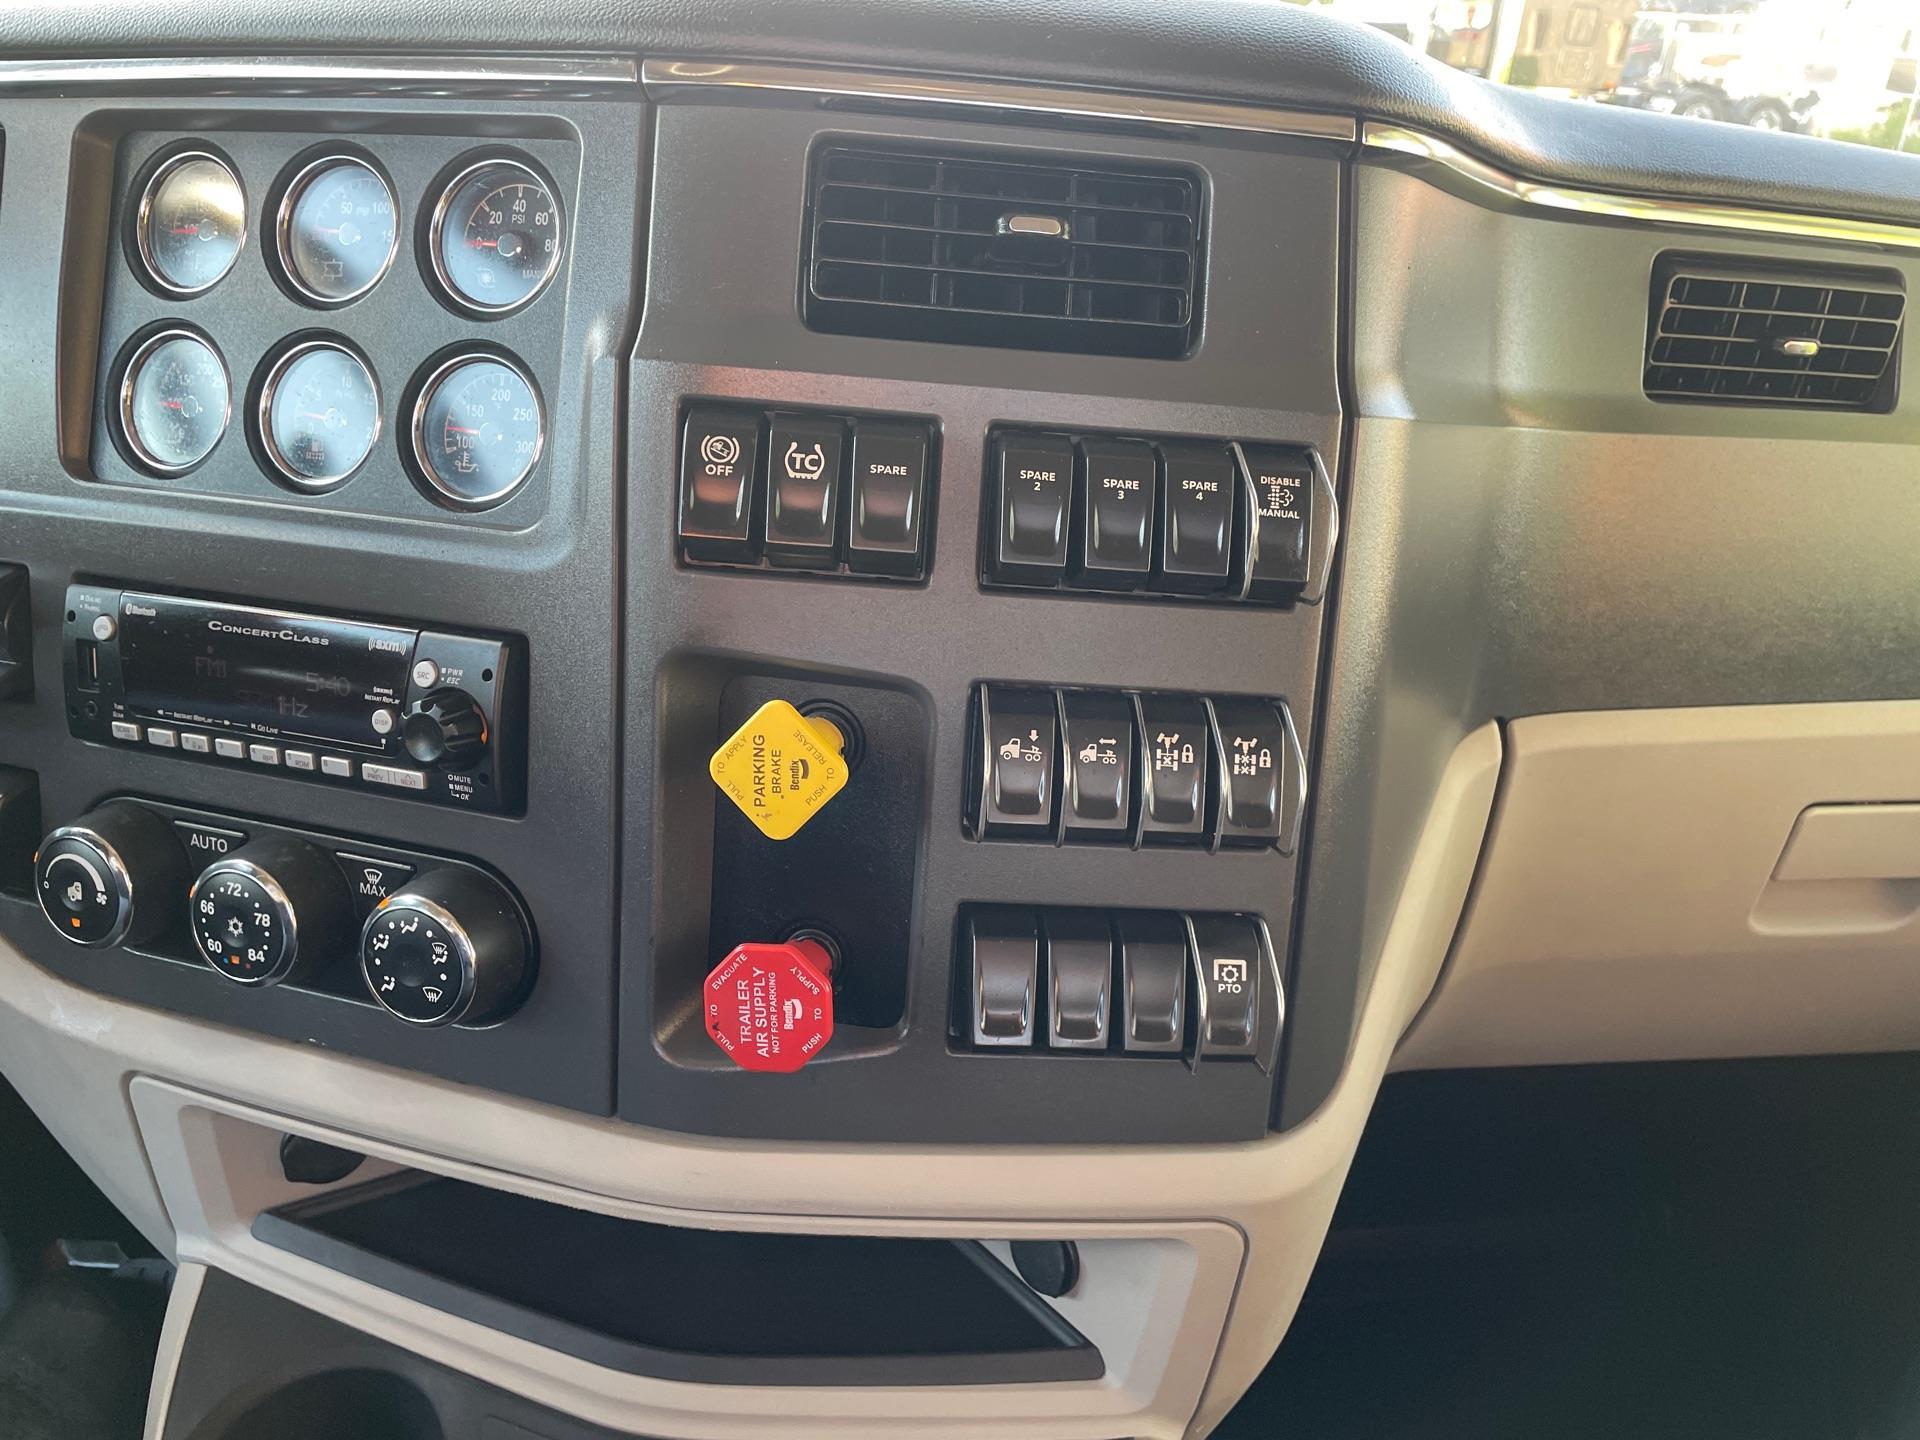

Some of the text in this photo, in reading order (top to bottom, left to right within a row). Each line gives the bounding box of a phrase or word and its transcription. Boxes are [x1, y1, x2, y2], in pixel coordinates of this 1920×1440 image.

[340, 201, 353, 215] 50
[372, 201, 390, 214] 100
[513, 199, 526, 212] 40
[489, 211, 502, 224] 20
[511, 214, 525, 224] PSI
[535, 211, 548, 225] 60
[544, 239, 556, 253] 80
[491, 388, 511, 402] 200
[466, 405, 484, 417] 150
[513, 408, 533, 420] 250
[456, 434, 475, 448] 100
[515, 441, 534, 453] 300
[792, 452, 819, 471] TC
[705, 464, 733, 476] OFF
[869, 464, 907, 475] SPARE
[1020, 469, 1056, 482] SPARE
[1033, 481, 1041, 491] 2
[1103, 478, 1140, 490] SPARE
[1182, 479, 1218, 492] SPARE
[1260, 475, 1301, 487] DISABLE
[1117, 489, 1125, 500] 3
[1196, 492, 1204, 502] 4
[1258, 507, 1300, 520] MANUAL
[416, 671, 430, 680] SRC
[447, 668, 464, 677] PWR
[446, 676, 461, 685] ESC
[717, 735, 747, 801] PULL TO APPLY
[752, 734, 766, 808] PARKING
[771, 748, 782, 794] BRAKE
[792, 729, 835, 806] PUSH TO RELEASE
[453, 774, 472, 784] MUTE
[789, 759, 800, 791] Bendix
[454, 783, 473, 793] MENU
[460, 793, 470, 801] OK
[190, 833, 228, 853] AUTO
[226, 881, 242, 897] 72
[359, 882, 386, 897] MAX
[200, 899, 215, 915] 66
[253, 912, 271, 927] 78
[207, 937, 222, 954] 60
[247, 948, 265, 963] 84
[1217, 983, 1242, 994] PTO
[710, 952, 748, 1052] PULL TO EVACUATE
[737, 979, 753, 1045] TRAILER
[752, 966, 770, 1058] AIR SUPPLY
[768, 971, 780, 1054] NOT FOR PARKING
[783, 999, 794, 1030] Bendix
[789, 966, 823, 1054] PUSH TO SUPPLY
